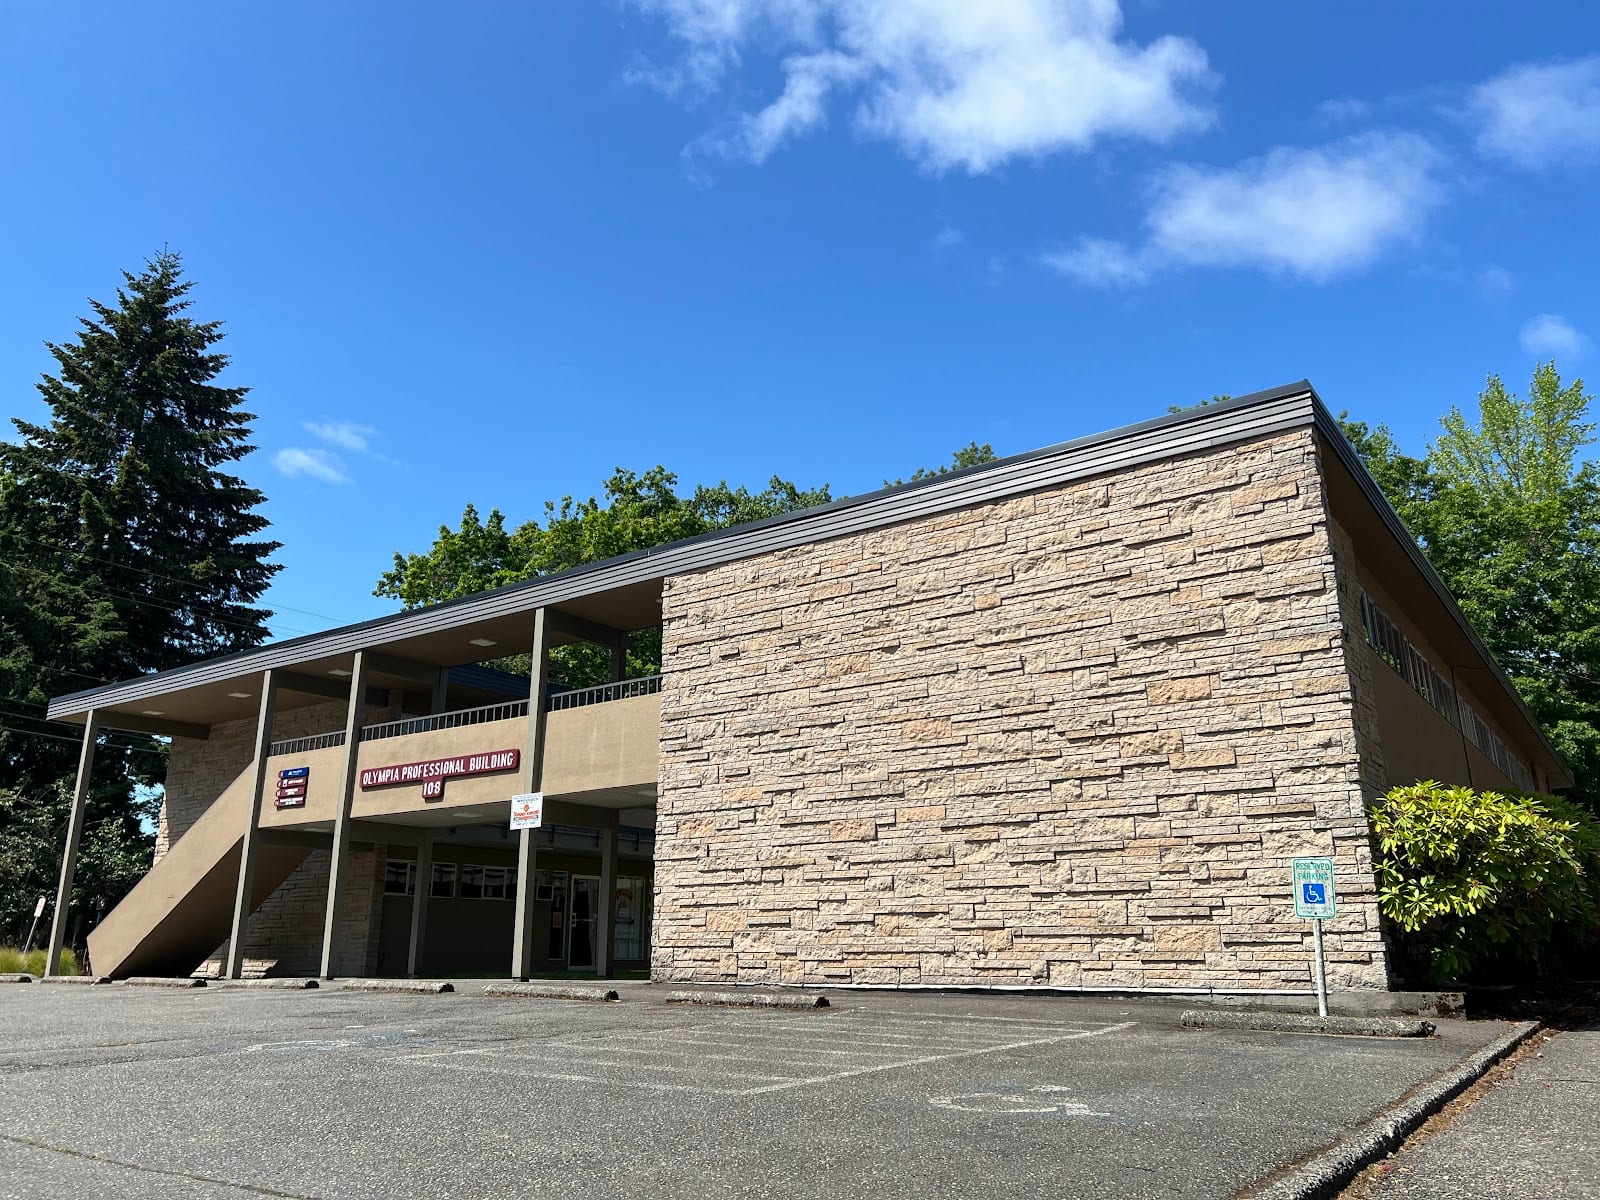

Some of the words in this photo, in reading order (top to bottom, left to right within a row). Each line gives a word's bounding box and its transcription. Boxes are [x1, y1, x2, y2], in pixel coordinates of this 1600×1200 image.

[363, 769, 399, 785] OLYMPIA
[401, 759, 466, 780] PROFESSIONAL
[469, 752, 514, 771] BUILDING
[423, 782, 441, 796] 108
[1295, 862, 1330, 871] RESERVED
[1298, 872, 1328, 881] PARKING
